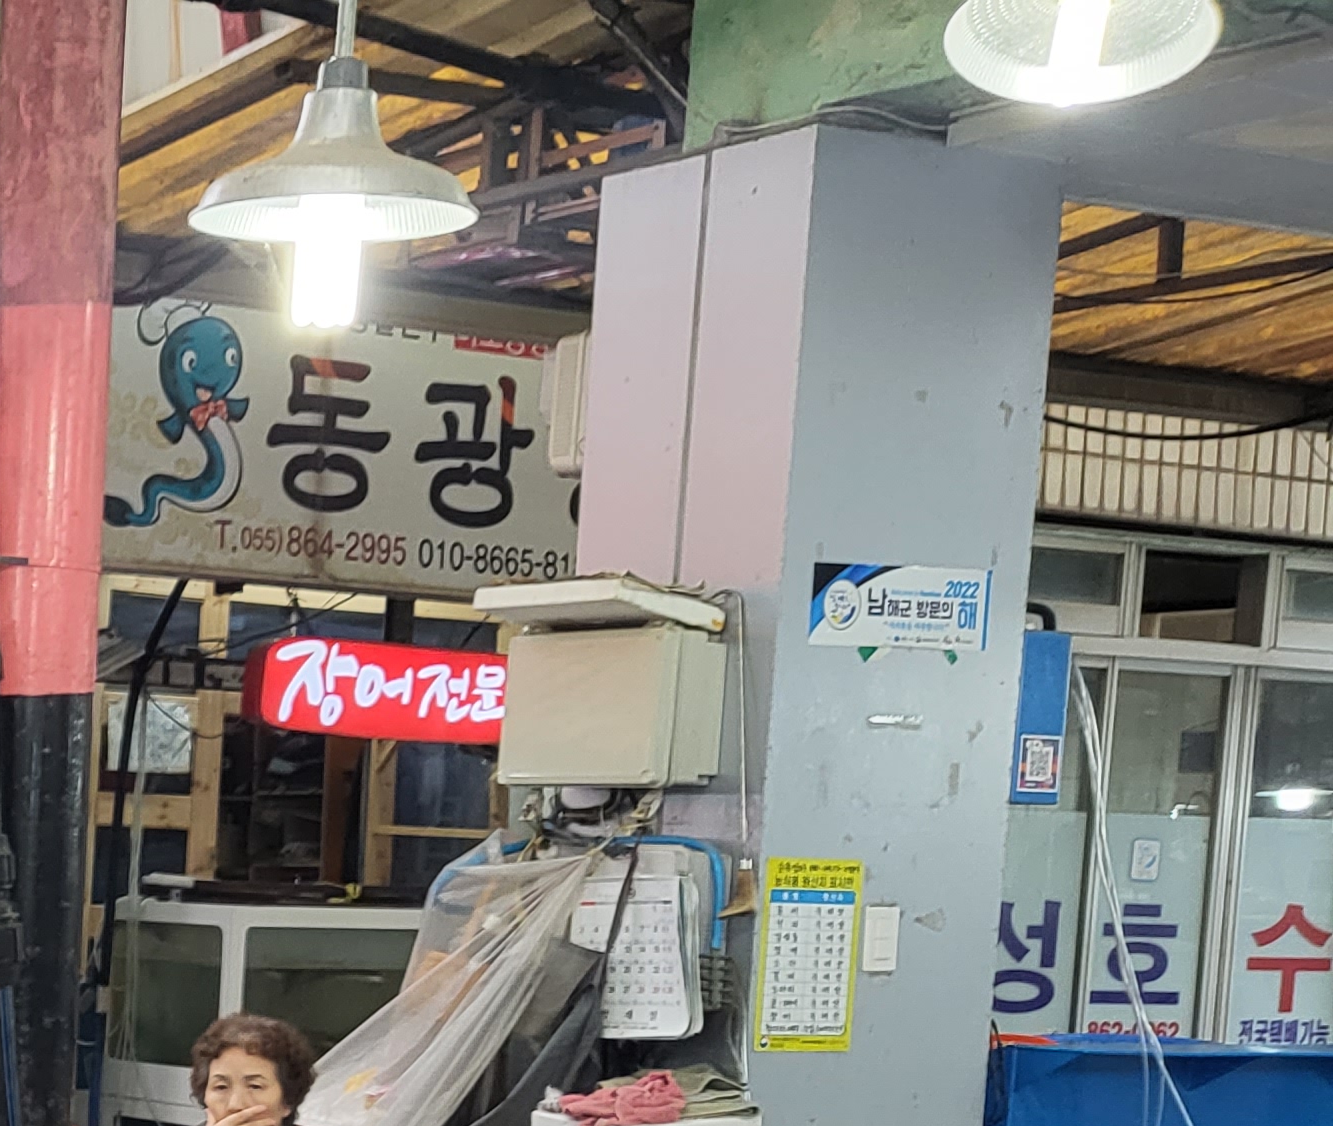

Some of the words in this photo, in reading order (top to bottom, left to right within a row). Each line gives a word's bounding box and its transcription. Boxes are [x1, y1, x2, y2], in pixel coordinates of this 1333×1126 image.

[266, 354, 580, 529] 동광
[868, 588, 912, 617] 남해군
[916, 600, 954, 619] 방문의
[958, 600, 978, 630] 해
[944, 581, 980, 599] 2022
